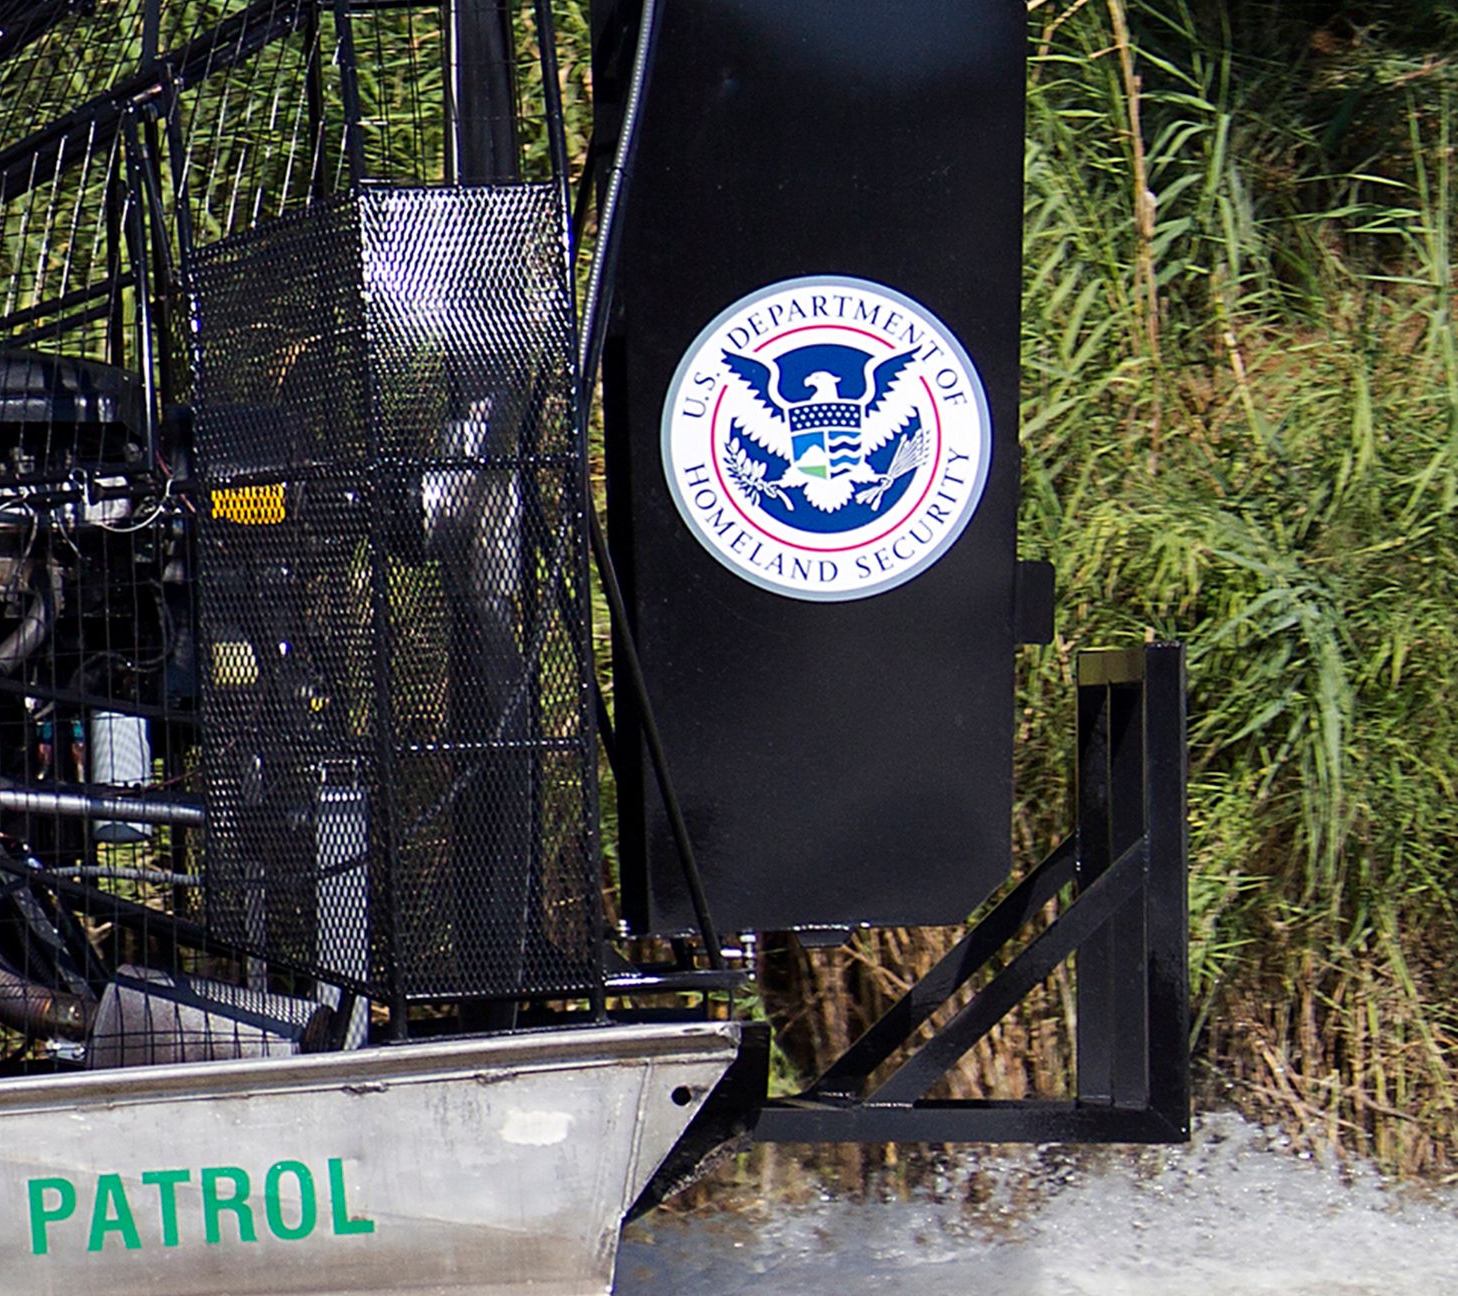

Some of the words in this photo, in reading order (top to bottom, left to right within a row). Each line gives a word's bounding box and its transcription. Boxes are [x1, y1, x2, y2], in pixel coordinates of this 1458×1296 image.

[682, 371, 720, 420] U.S.
[726, 294, 945, 364] DEPARTMENT
[935, 367, 968, 408] OF
[684, 462, 839, 583] HOMELAND
[857, 447, 971, 580] SECURITY
[27, 1157, 376, 1255] PATROL
